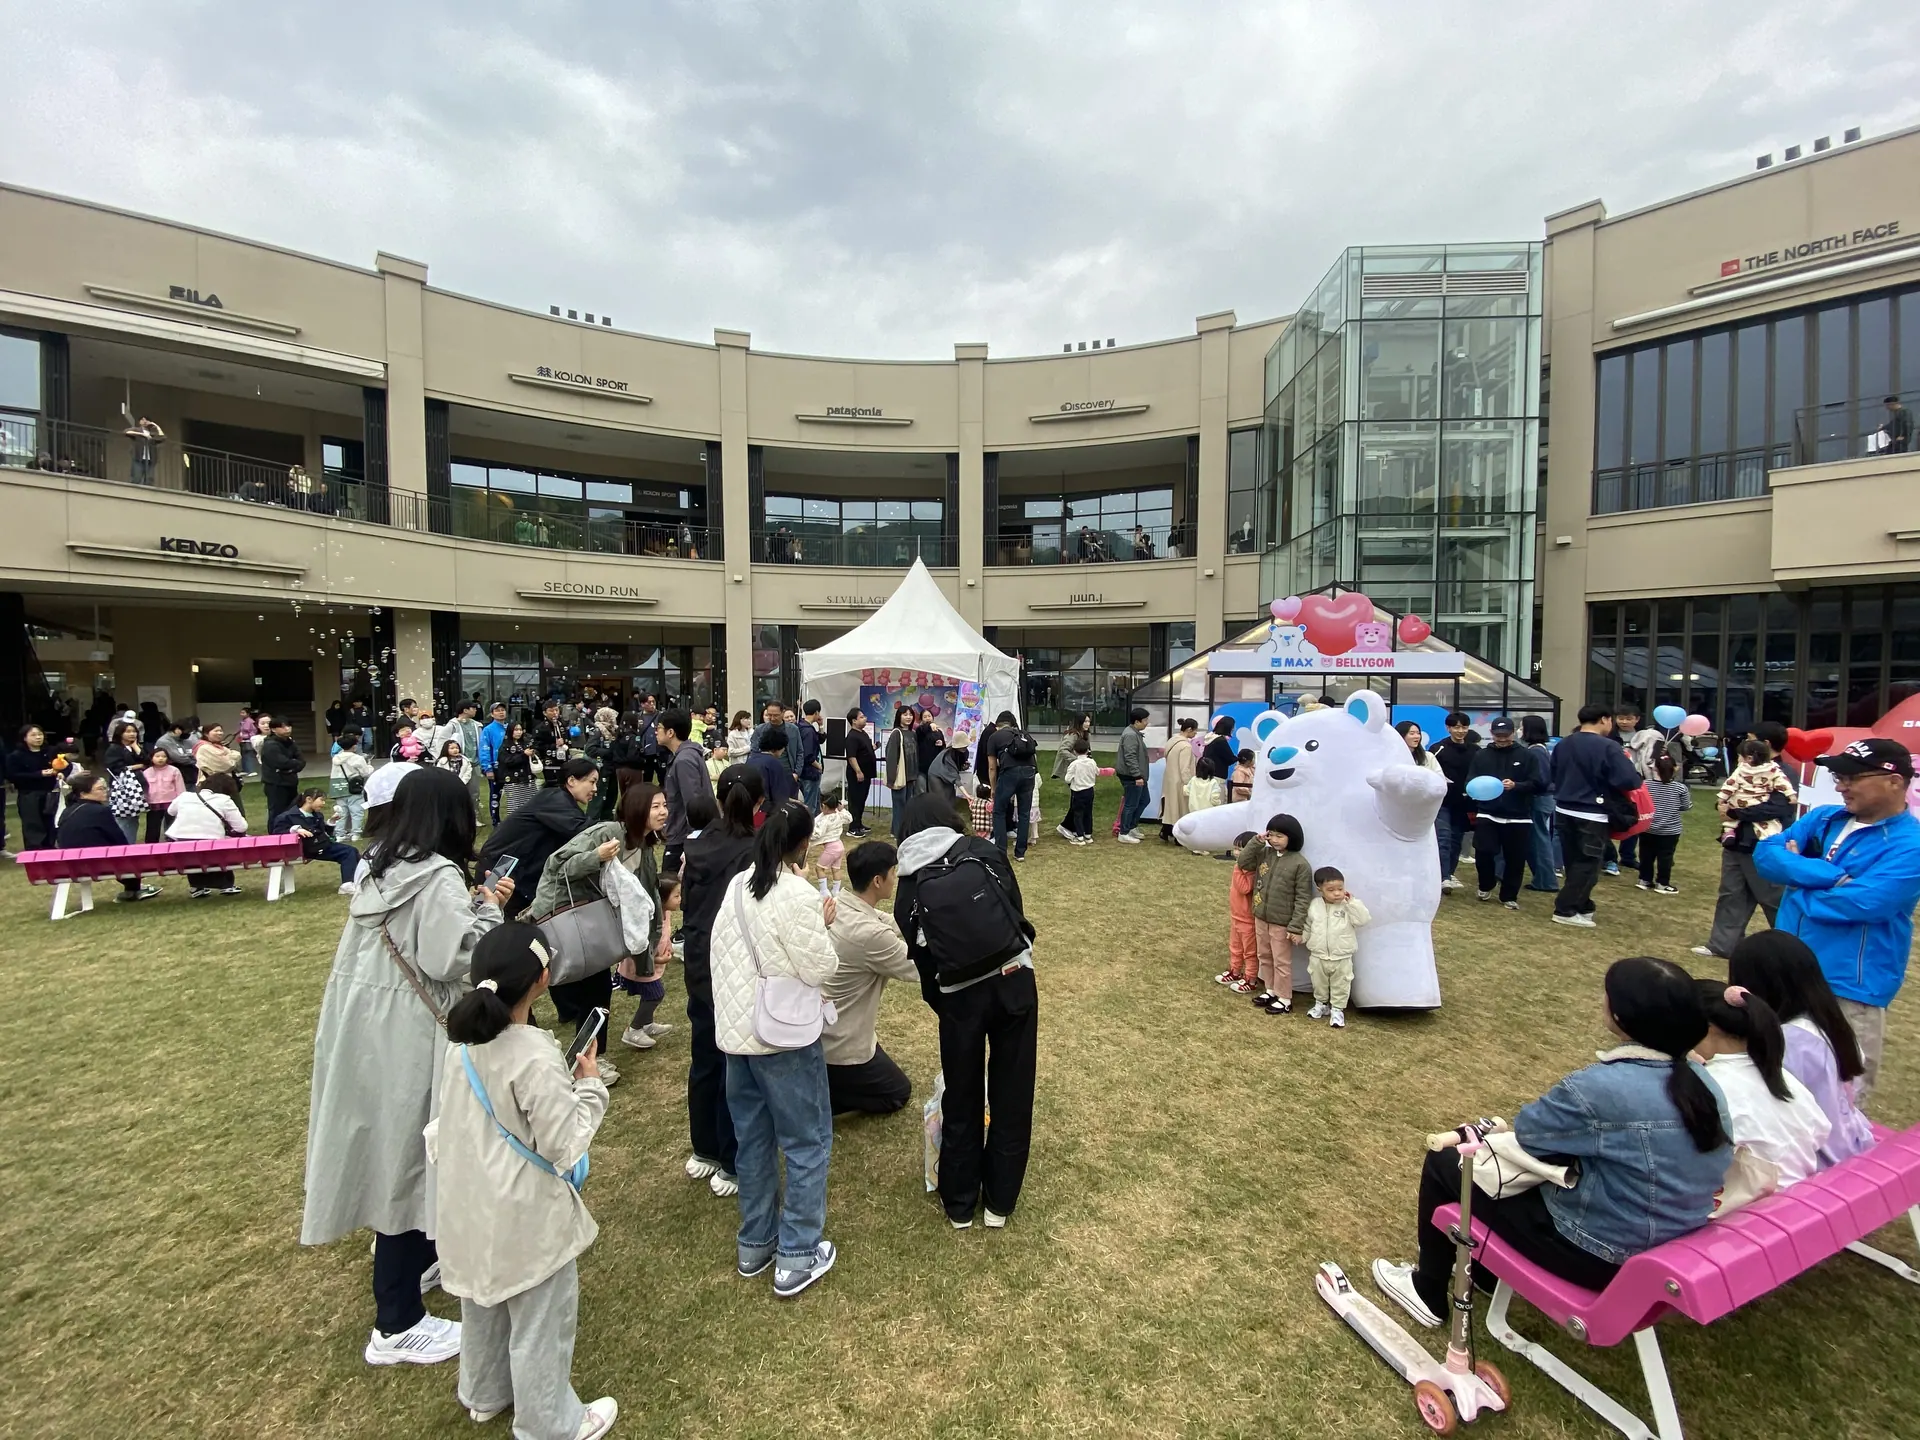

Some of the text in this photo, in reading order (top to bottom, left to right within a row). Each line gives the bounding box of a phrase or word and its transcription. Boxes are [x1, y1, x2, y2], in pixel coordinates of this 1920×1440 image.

[1744, 221, 1900, 270] THE NORTH FACE
[169, 285, 223, 308] FILA
[554, 370, 629, 392] KOLON SPORT
[826, 406, 883, 417] patagonia
[160, 536, 239, 559] KENZO
[543, 581, 639, 597] SECOND RUN
[1284, 657, 1395, 668] MAX BELLYGOM
